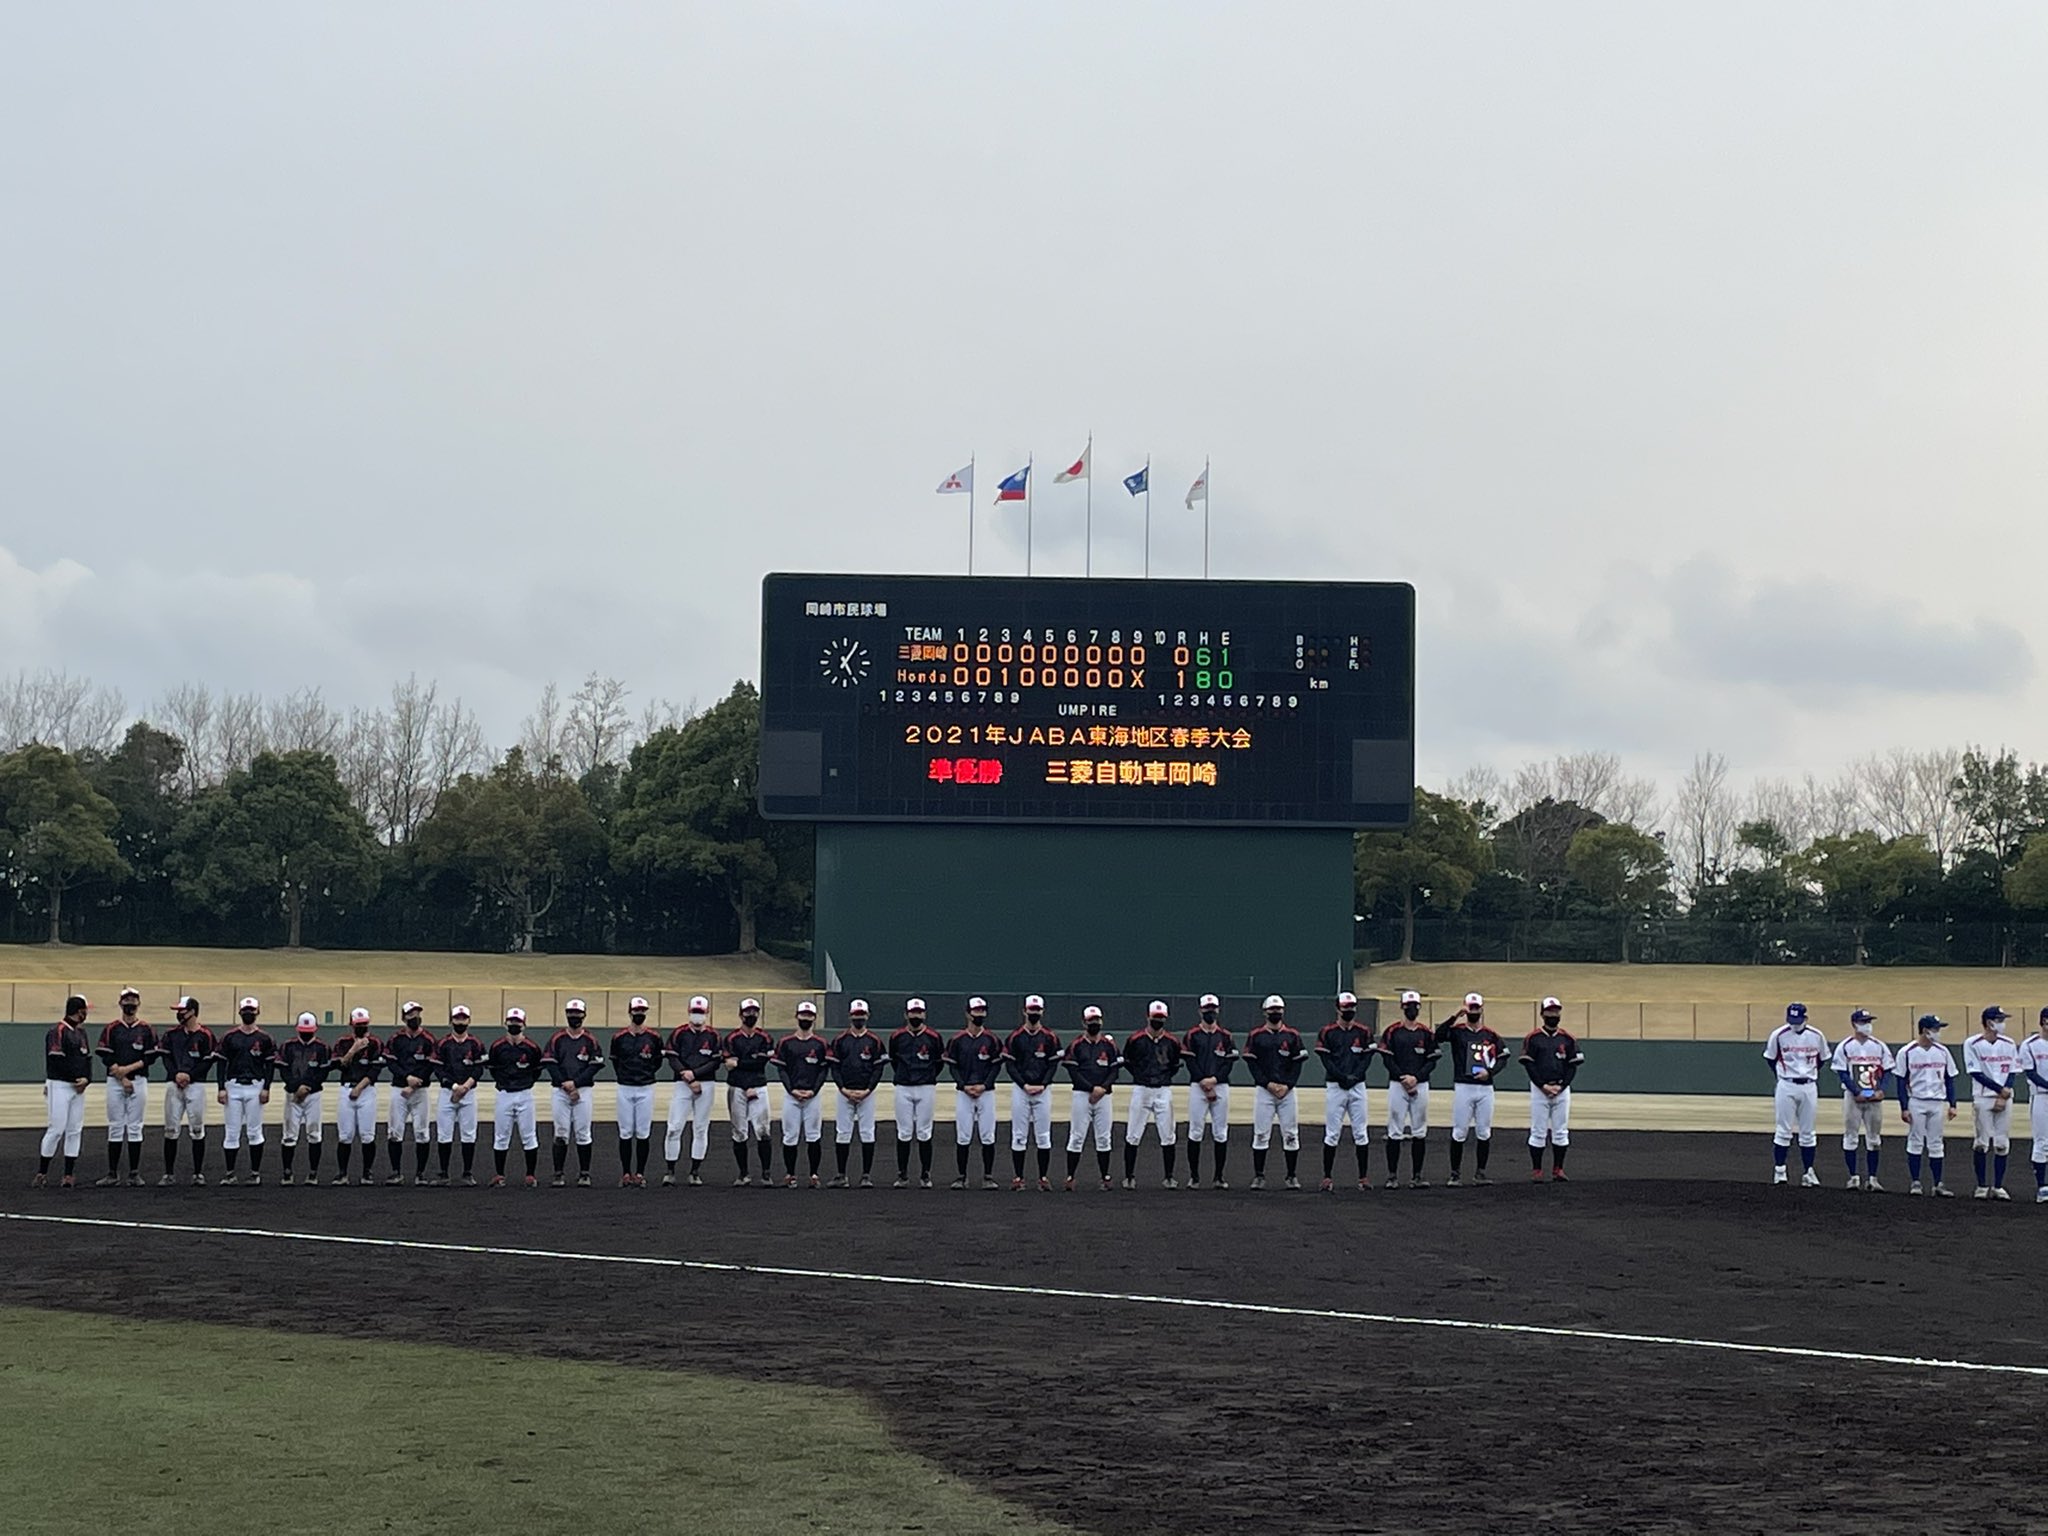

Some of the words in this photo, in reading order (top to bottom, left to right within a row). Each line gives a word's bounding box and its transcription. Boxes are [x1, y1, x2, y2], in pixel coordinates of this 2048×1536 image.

[805, 601, 887, 617] 岡崎市民球場
[904, 626, 942, 641] TEAM
[957, 627, 964, 642] 1
[979, 627, 989, 642] 2
[1001, 628, 1010, 643] 3
[1023, 628, 1033, 643] 4
[1045, 629, 1054, 643] 5
[1067, 629, 1077, 644] 6
[1089, 629, 1099, 644] 7
[1111, 629, 1121, 644] 8
[1133, 630, 1143, 644] 9
[1154, 630, 1166, 645] 10
[1177, 630, 1187, 645] R
[1199, 631, 1209, 645] H
[1221, 631, 1230, 646] E
[953, 643, 969, 663] 0
[976, 643, 991, 663] 0
[997, 644, 1013, 663] 0
[1020, 644, 1035, 664] 0
[1042, 644, 1057, 664] 0
[1064, 645, 1079, 665] 0
[1086, 645, 1102, 665] 0
[1108, 645, 1123, 665] 0
[1130, 646, 1146, 665] 0
[1174, 646, 1190, 666] 0
[1196, 647, 1211, 666] 6
[1221, 647, 1228, 666] 1
[897, 669, 947, 684] Honda
[953, 666, 969, 686] 0
[975, 666, 991, 686] 0
[1000, 667, 1008, 687] 1
[1019, 667, 1035, 687] 0
[1041, 667, 1057, 687] 0
[1064, 667, 1079, 688] 0
[1085, 668, 1102, 688] 0
[1107, 668, 1123, 688] 0
[1130, 669, 1145, 688] X
[1177, 669, 1184, 689] 1
[1196, 670, 1211, 689] 8
[1218, 670, 1233, 689] 0
[1309, 677, 1329, 689] km
[879, 689, 886, 702] 1
[895, 690, 905, 702] 2
[911, 690, 921, 703] 3
[928, 690, 938, 703] 4
[944, 690, 954, 703] 5
[961, 691, 971, 703] 6
[977, 691, 987, 703] 7
[994, 691, 1003, 704] 8
[1010, 691, 1020, 704] 9
[1158, 694, 1165, 706] 1
[1173, 694, 1184, 707] 2
[1190, 694, 1200, 707] 3
[1206, 694, 1216, 707] 4
[1223, 694, 1232, 707] 5
[1239, 695, 1249, 707] 6
[1255, 695, 1265, 707] 7
[1272, 695, 1282, 708] 8
[1288, 695, 1298, 708] 9
[1058, 703, 1117, 717] UMPIRE
[905, 723, 1252, 749] 2021年JABA東海地区春季大会
[1045, 759, 1218, 787] 三菱自動車岡崎
